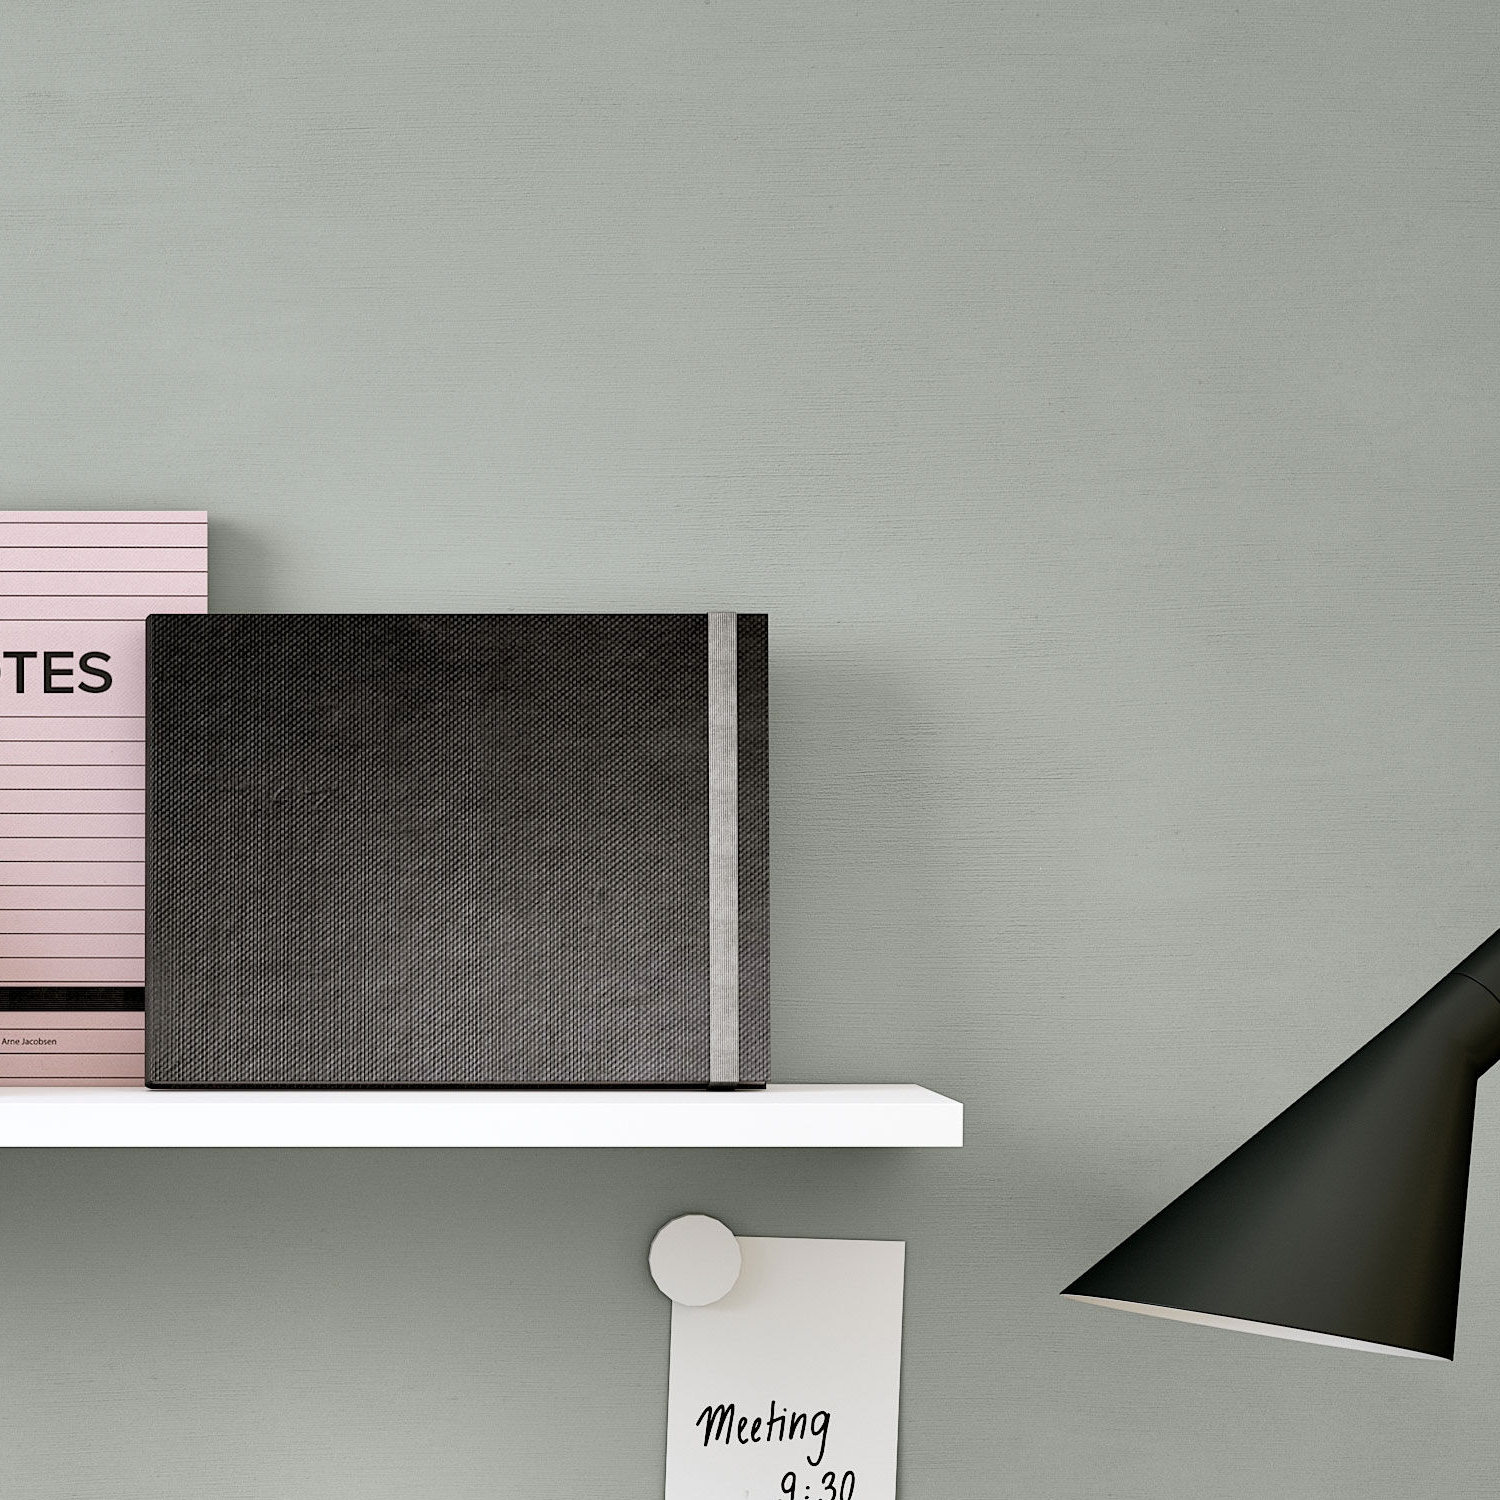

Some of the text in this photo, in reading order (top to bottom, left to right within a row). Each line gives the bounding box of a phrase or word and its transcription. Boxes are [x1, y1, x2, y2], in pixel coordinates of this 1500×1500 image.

[1, 1037, 20, 1045] Arne
[21, 1037, 58, 1046] Jacobsen
[696, 1400, 831, 1466] Meeting
